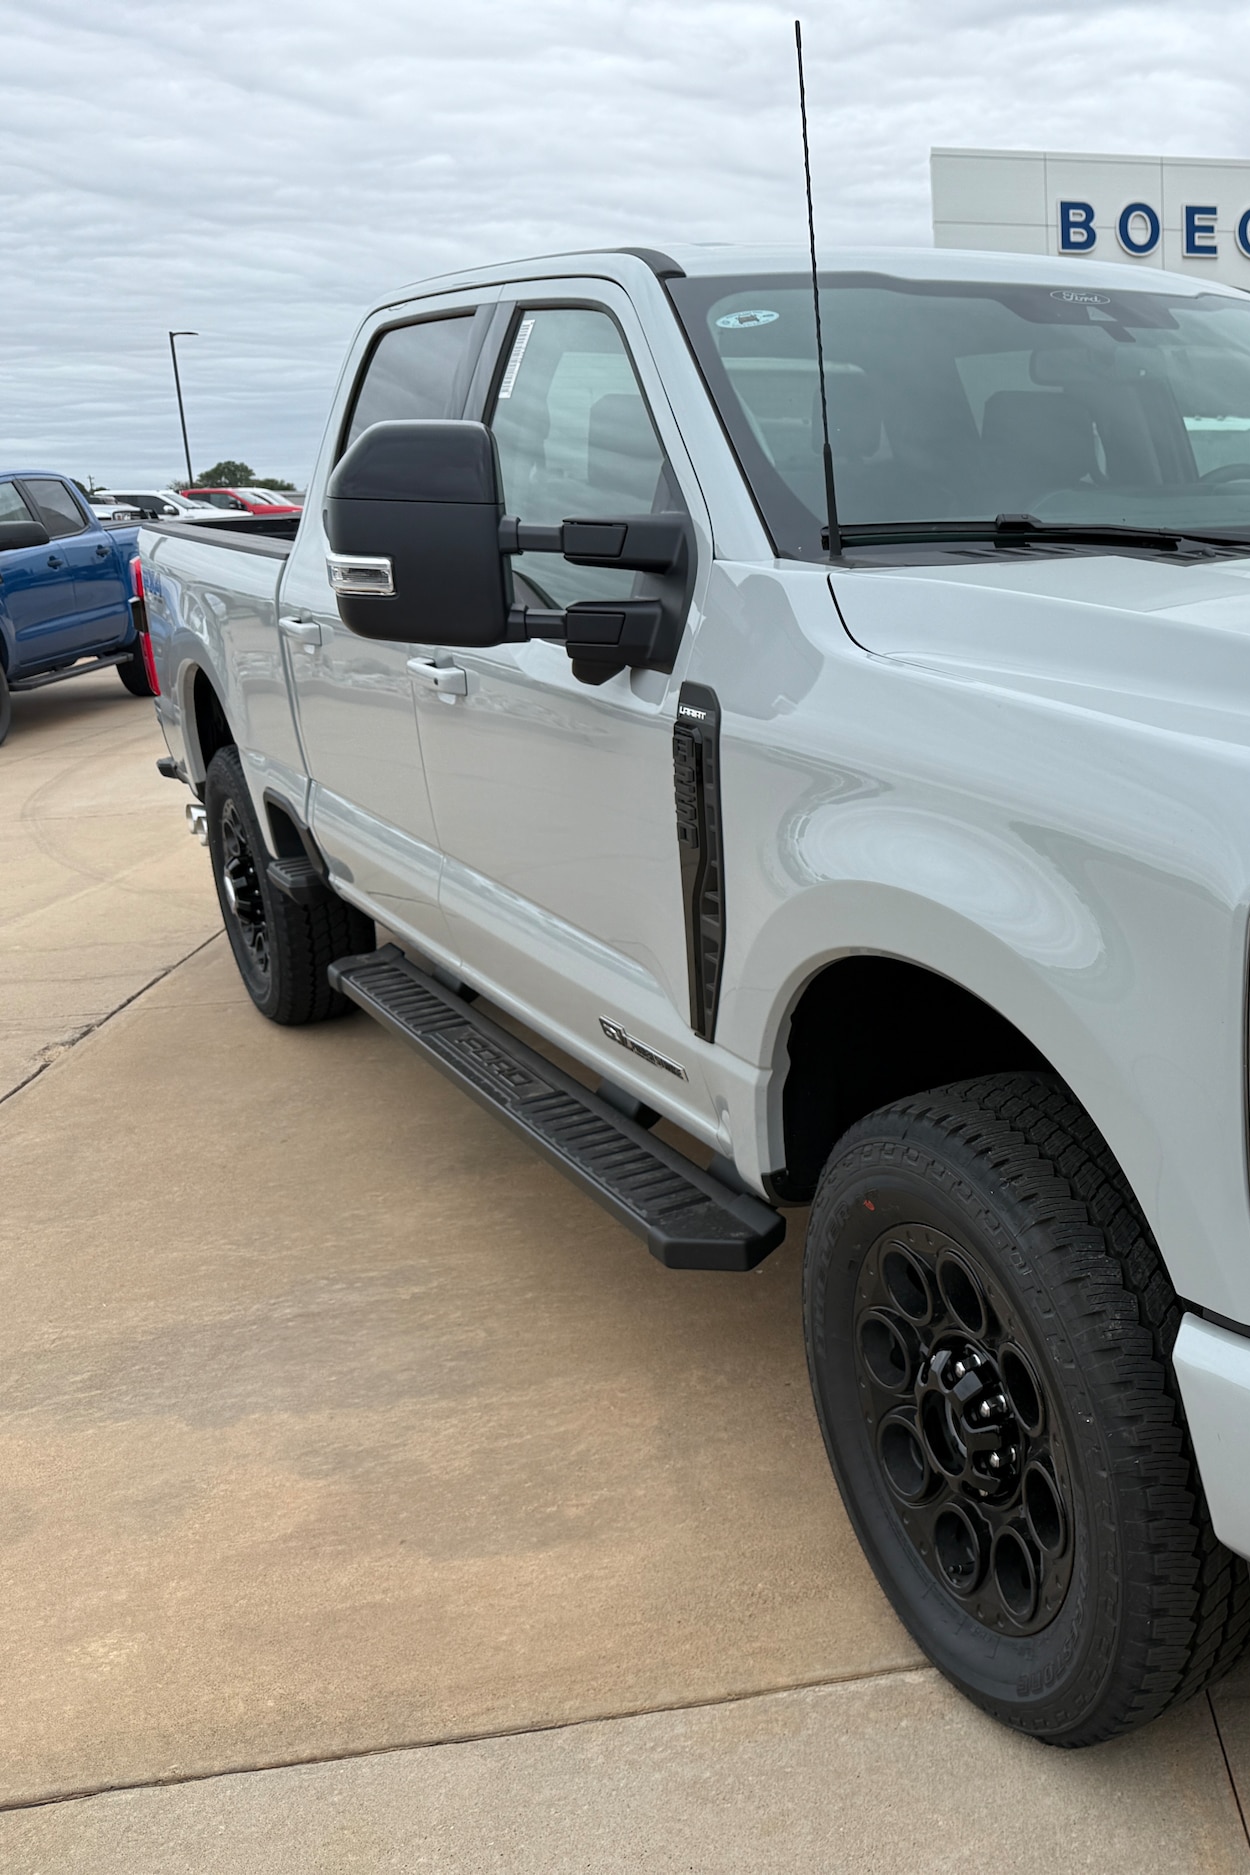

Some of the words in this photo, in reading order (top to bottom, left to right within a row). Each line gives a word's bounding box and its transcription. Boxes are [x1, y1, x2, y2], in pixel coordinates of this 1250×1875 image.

[1062, 292, 1101, 303] Ford
[679, 706, 707, 721] LARIAT
[454, 1037, 534, 1087] FORD
